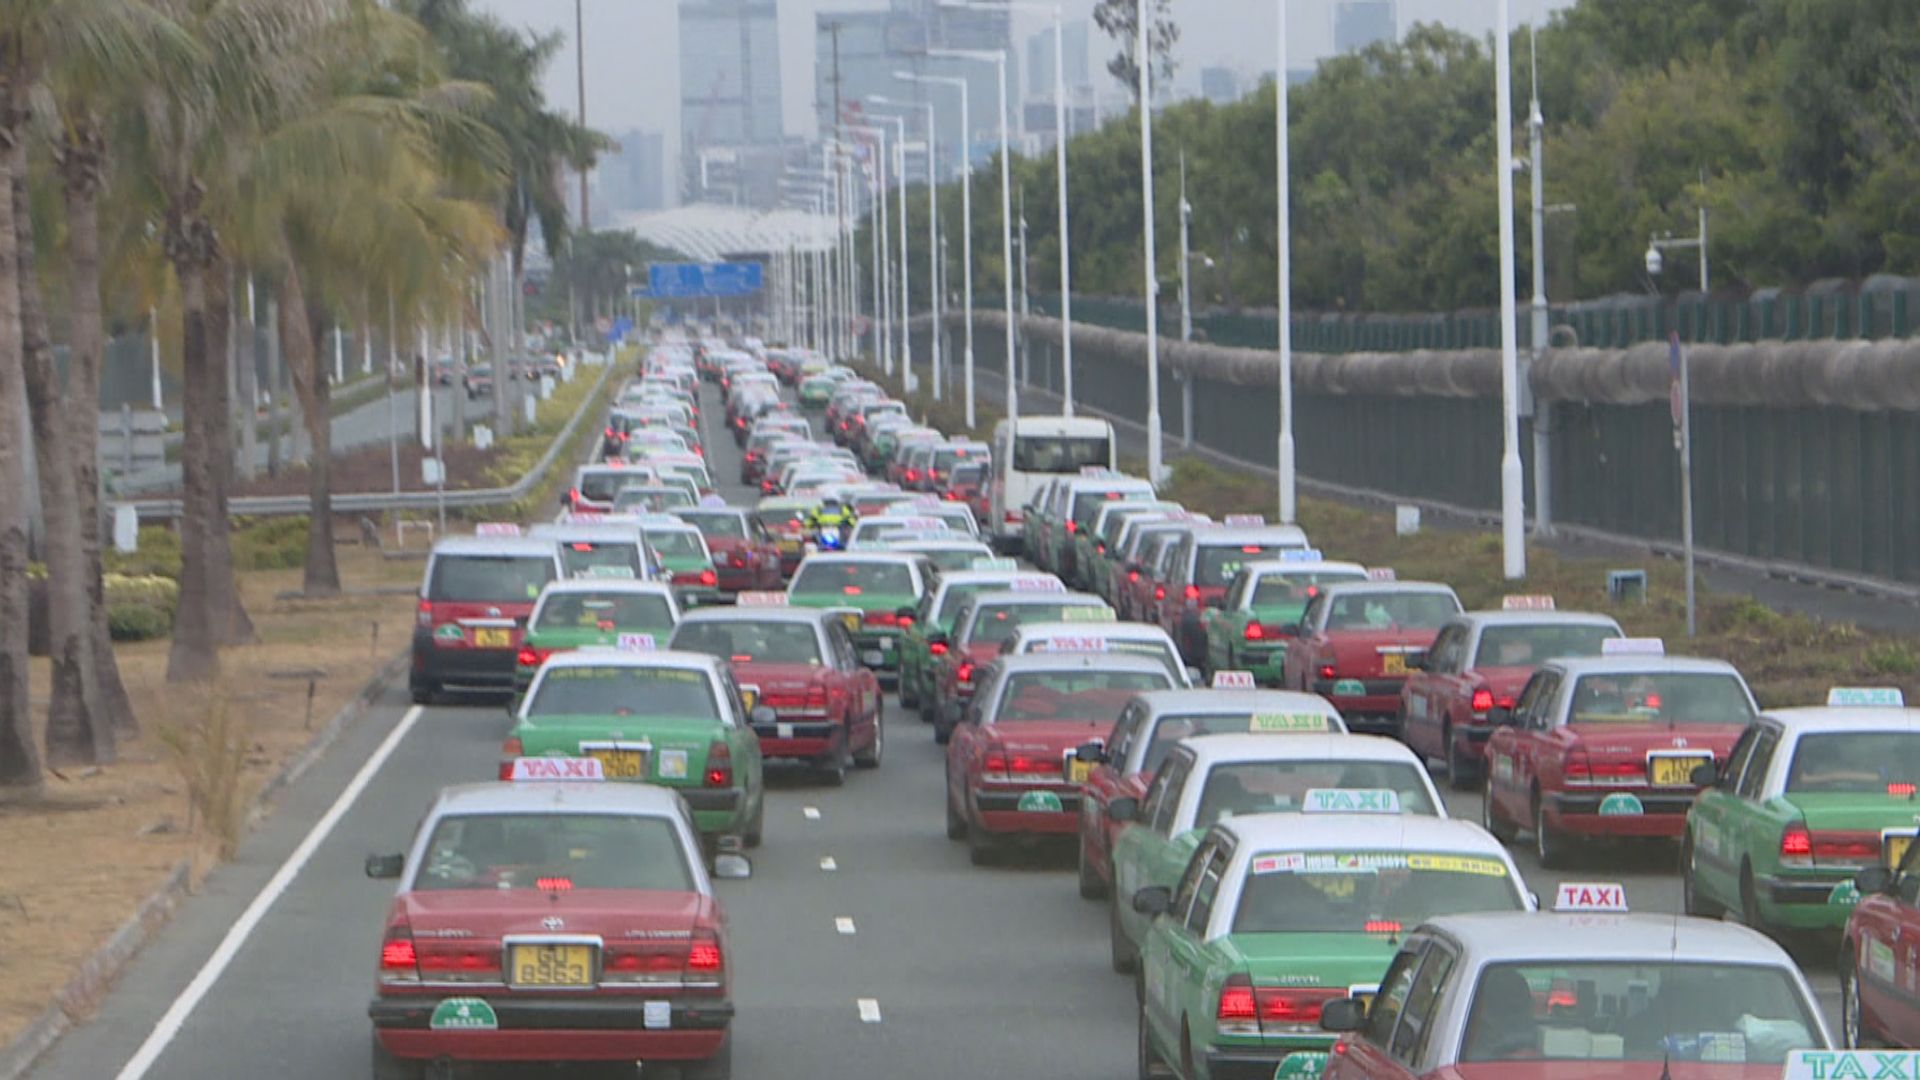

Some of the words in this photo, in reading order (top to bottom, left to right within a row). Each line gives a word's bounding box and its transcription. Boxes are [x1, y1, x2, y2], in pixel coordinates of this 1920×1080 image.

[621, 635, 651, 647] TAXI
[1051, 636, 1105, 649] TAXI
[1218, 674, 1252, 686] TAXI
[1836, 690, 1896, 704] TAXI
[1256, 713, 1322, 728] TAXI
[522, 760, 596, 777] TAXI
[1313, 791, 1390, 809] TAXI
[1564, 888, 1621, 906] TAXI
[1302, 1059, 1316, 1073] 4
